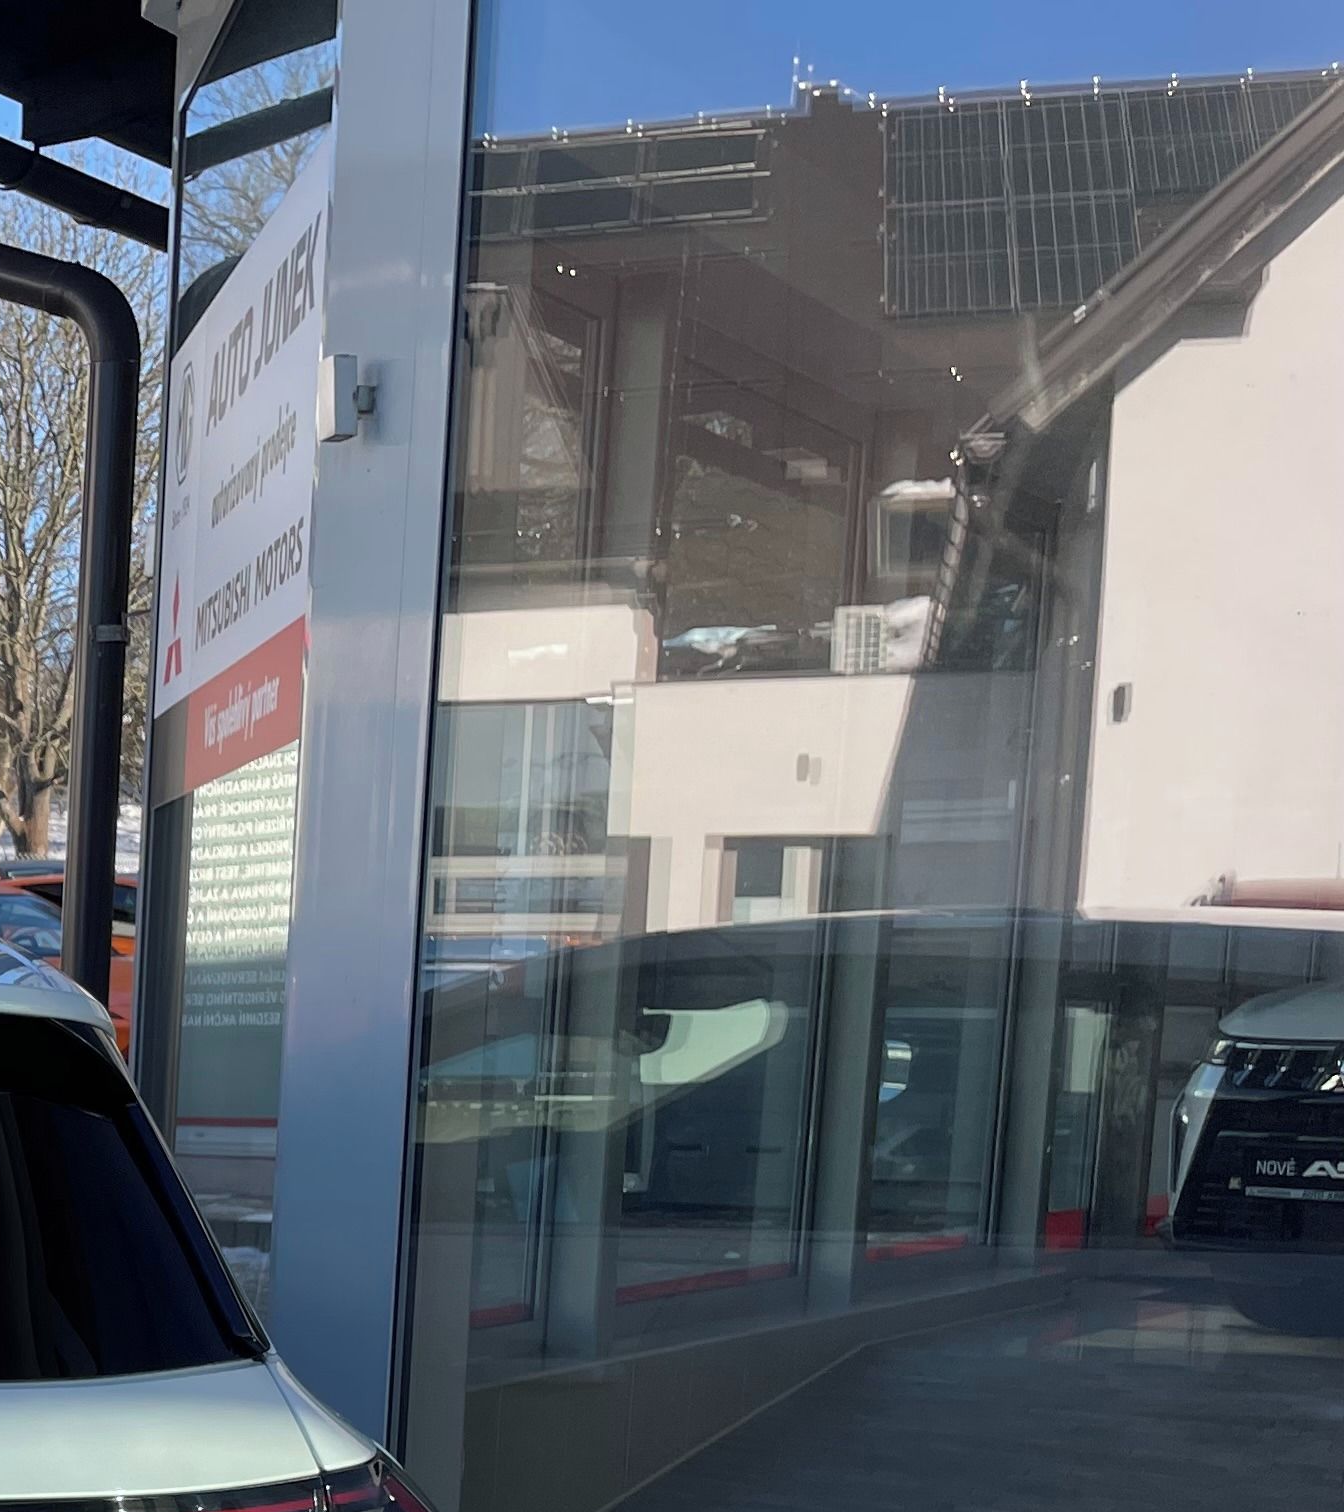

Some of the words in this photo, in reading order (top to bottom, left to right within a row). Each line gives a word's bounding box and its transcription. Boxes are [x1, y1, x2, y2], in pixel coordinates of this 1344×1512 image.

[206, 305, 254, 437] AUTO
[254, 210, 322, 380] JUNEK
[195, 564, 251, 651] MITSUBISHI
[254, 516, 304, 606] MOTORS
[1256, 1157, 1296, 1177] NOVÉ
